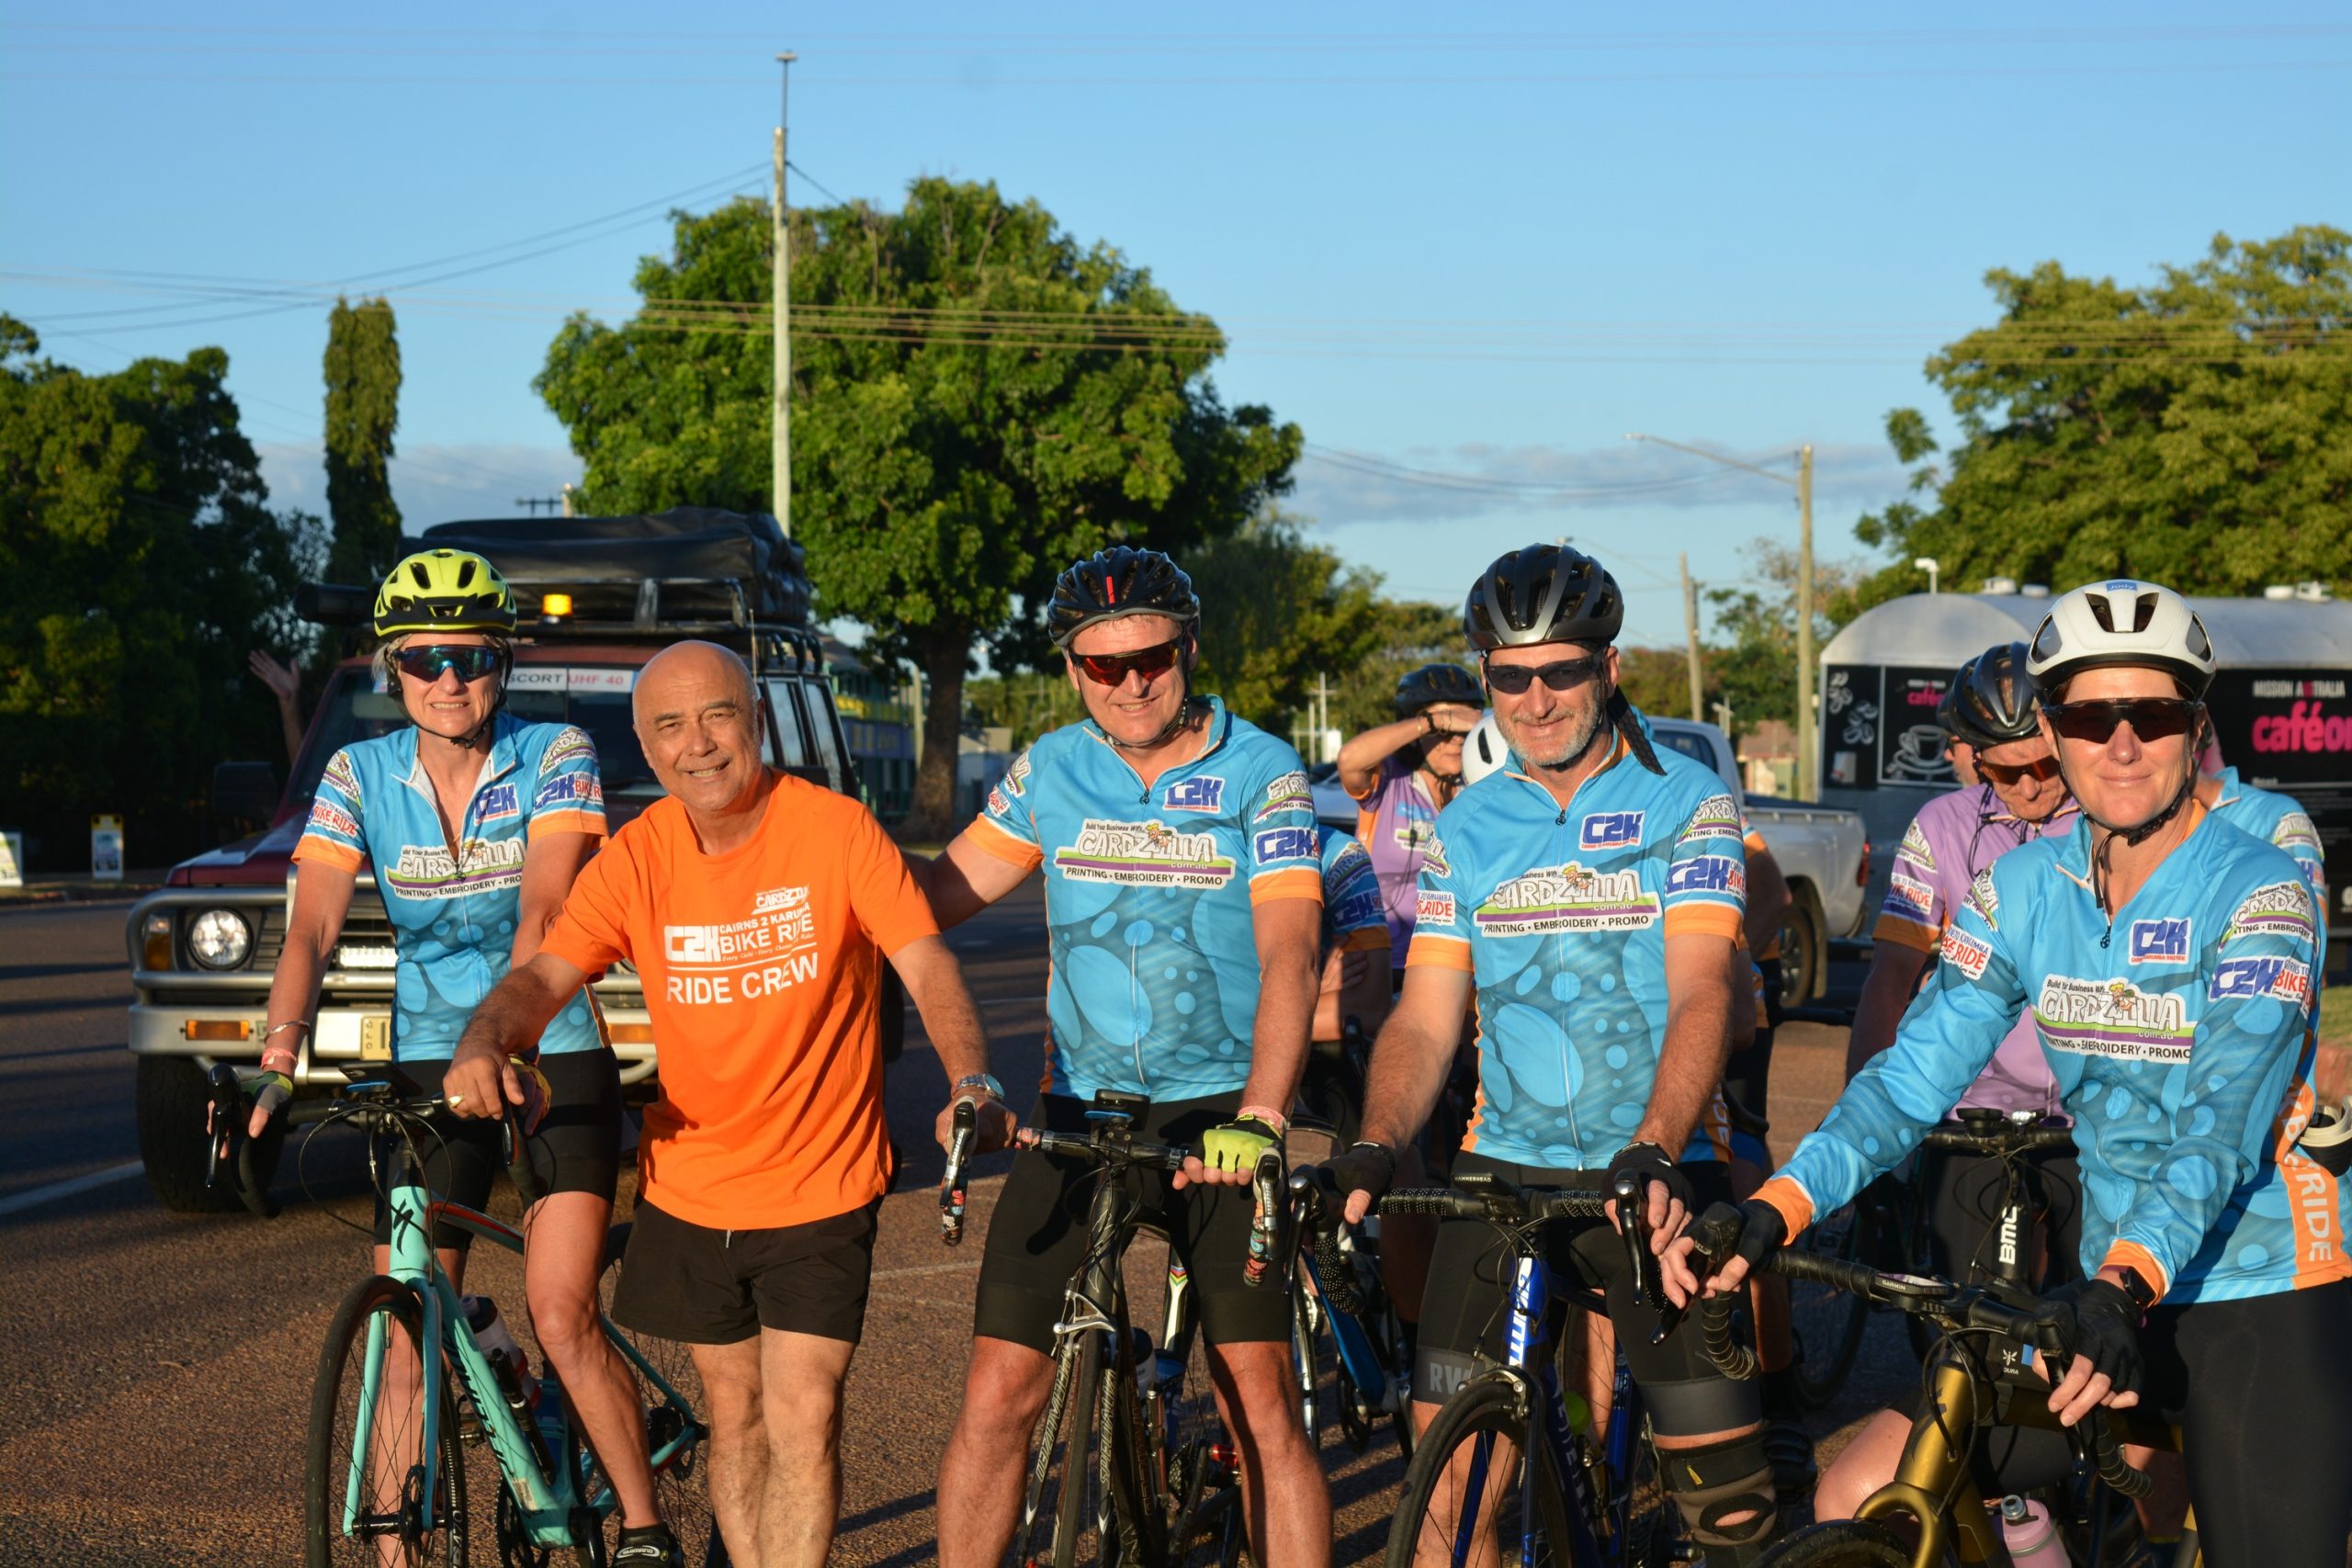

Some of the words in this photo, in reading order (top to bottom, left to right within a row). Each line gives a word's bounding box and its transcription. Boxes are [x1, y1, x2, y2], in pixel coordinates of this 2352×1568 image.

[507, 673, 563, 683] SCORT
[568, 675, 600, 684] UHF
[605, 675, 625, 685] 40
[2253, 680, 2293, 698] MISSION
[574, 780, 593, 795] BIKE
[1167, 777, 1223, 807] C2K
[313, 806, 333, 822] BIKE
[333, 813, 356, 835] RIDE
[1582, 813, 1644, 844] C2K
[1078, 831, 1214, 863] CARDZILLA
[1256, 829, 1313, 863] C2K
[396, 887, 432, 897] PRINTING
[439, 879, 496, 896] EMBROIDERY
[503, 874, 522, 885] PRO
[1066, 867, 1108, 879] PRINTING
[1114, 872, 1174, 883] EMBROIDERY
[1183, 875, 1223, 886] PROMO
[1493, 873, 1639, 909] CARDZILLA
[1667, 858, 1731, 895] C2K
[1591, 903, 1633, 911] .com.au
[1906, 886, 1932, 906] RIDE
[719, 919, 759, 934] CAIRNS
[761, 917, 769, 926] 2
[770, 902, 810, 925] KARUA
[1484, 924, 1525, 933] PRINTING
[1533, 918, 1599, 931] EMBROIDERY
[1608, 915, 1649, 926] PROMO
[663, 925, 721, 963] C2K
[720, 928, 772, 954] BIKE
[2132, 919, 2188, 957] C2K
[1953, 942, 1986, 970] RIDE
[667, 976, 733, 1005] RIDE
[741, 952, 818, 999] CREW
[2046, 978, 2061, 989] Build
[2068, 983, 2094, 992] Business
[2211, 958, 2284, 999] C2K
[2274, 969, 2307, 992] BIKE
[2042, 990, 2180, 1032] CARDZILLA
[2135, 1030, 2174, 1040] .com.au
[2296, 1173, 2333, 1261] RIDE
[1999, 1206, 2018, 1265] BMC
[1882, 1280, 1905, 1291] GARMIN
